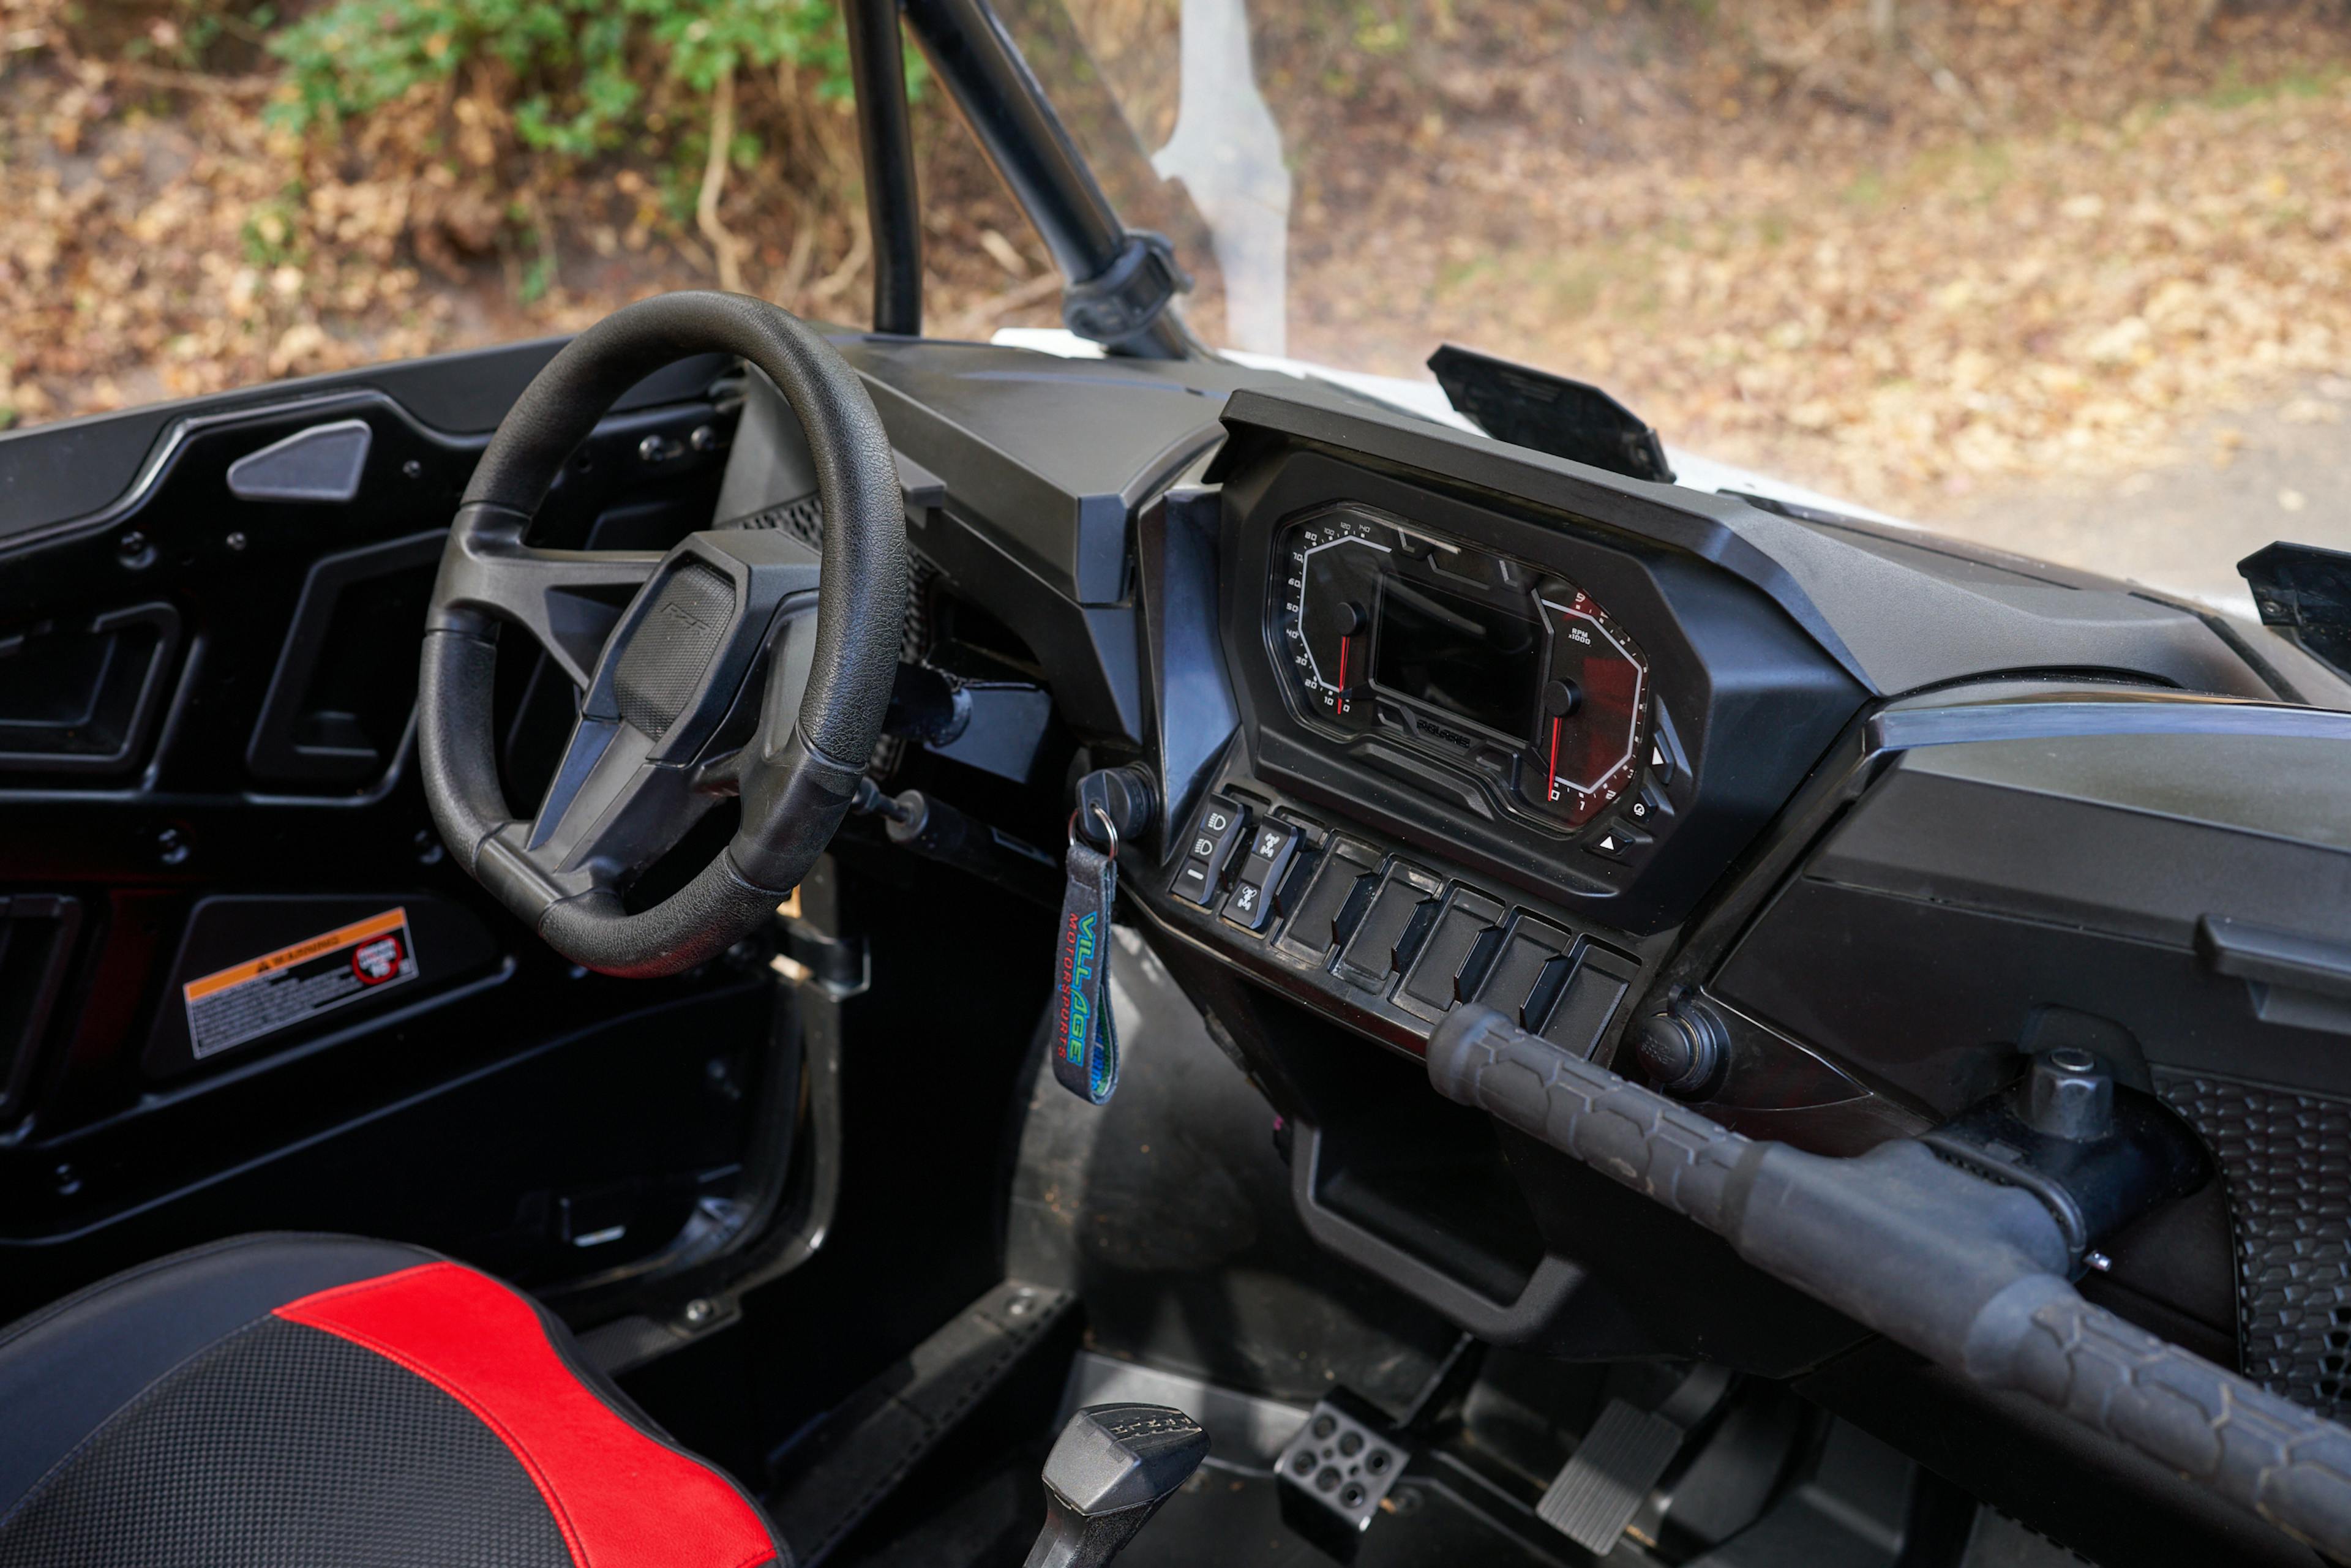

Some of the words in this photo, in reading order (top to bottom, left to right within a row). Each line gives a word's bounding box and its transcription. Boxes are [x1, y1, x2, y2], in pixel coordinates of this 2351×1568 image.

[1324, 527, 1335, 536] 100
[1359, 524, 1370, 533] 140
[1305, 531, 1317, 541] 80
[1293, 552, 1303, 562] 70
[1288, 578, 1301, 588] 60
[1575, 592, 1586, 602] 9
[1286, 602, 1299, 612] 50
[1286, 629, 1298, 639] 40
[1572, 628, 1588, 638] RPM
[1568, 634, 1591, 645] x1000
[1295, 656, 1307, 666] 30
[1305, 679, 1317, 689] 20
[1324, 696, 1333, 706] 10
[1551, 790, 1560, 801] 0
[1605, 789, 1616, 800] 2
[1580, 801, 1585, 811] 1
[1058, 913, 1079, 1059] MOTORSPORTS
[1067, 911, 1097, 1067] VILLAGE
